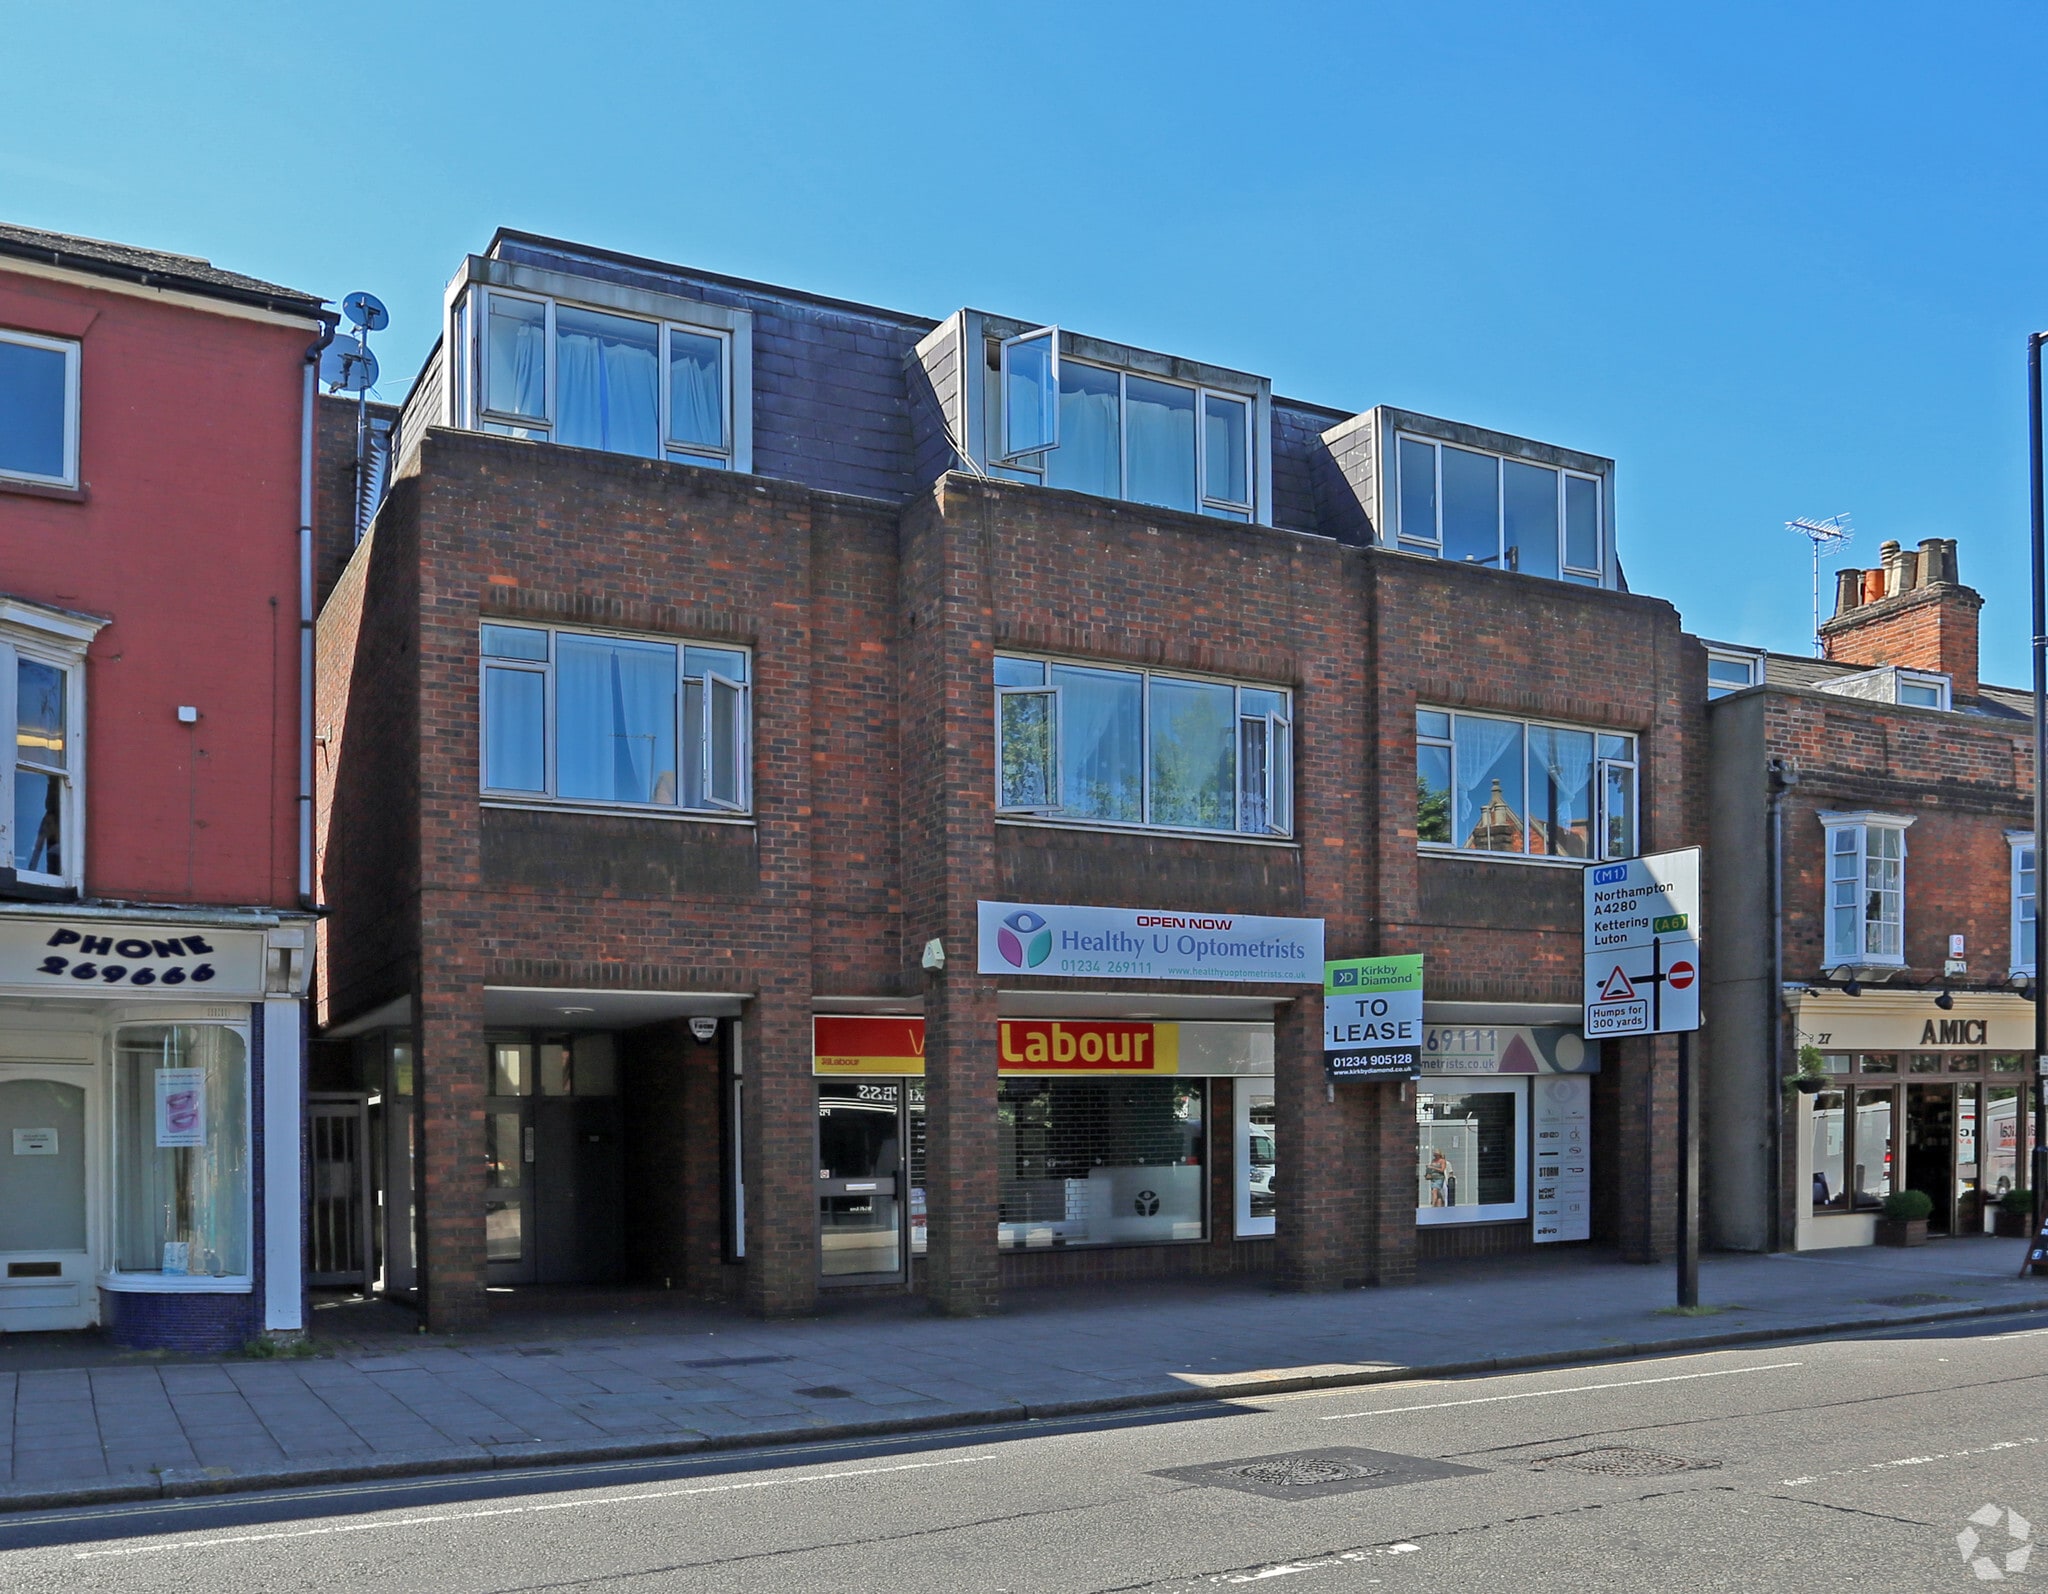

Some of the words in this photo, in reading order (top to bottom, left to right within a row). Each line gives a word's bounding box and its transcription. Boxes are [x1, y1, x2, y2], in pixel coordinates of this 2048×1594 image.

[1594, 883, 1674, 903] Northampton
[1594, 900, 1637, 916] A4280
[1136, 915, 1186, 929] OPEN
[1189, 917, 1233, 931] NOW
[1594, 917, 1649, 932] Kettering
[46, 928, 214, 959] PHONE
[1061, 930, 1145, 959] Healthy
[1153, 934, 1169, 954] U
[1176, 934, 1305, 962] Optometrists
[1594, 934, 1628, 946] Luton
[36, 955, 215, 985] 269666
[1061, 959, 1101, 972] 01234
[1107, 961, 1152, 974] 269111
[1168, 966, 1306, 979] www.healthyuoptometrists.co.uk
[1361, 965, 1398, 976] Kirkby
[1361, 973, 1412, 986] Diamond
[1355, 999, 1389, 1018] TO
[1593, 1008, 1626, 1018] Humps
[1628, 1006, 1642, 1015] for
[1593, 1018, 1614, 1029] 300
[1616, 1016, 1643, 1028] yards
[1333, 1021, 1412, 1043] LEASE
[1817, 1033, 1832, 1045] 27
[1920, 1018, 1988, 1046] AMICI
[1001, 1023, 1150, 1062] Labour
[1421, 1029, 1495, 1052] 69111
[1333, 1056, 1368, 1068] 01234
[1370, 1053, 1413, 1066] 905128
[1333, 1066, 1412, 1076] www.kirkbydiamond.co.uk
[1539, 1167, 1560, 1178] STORM
